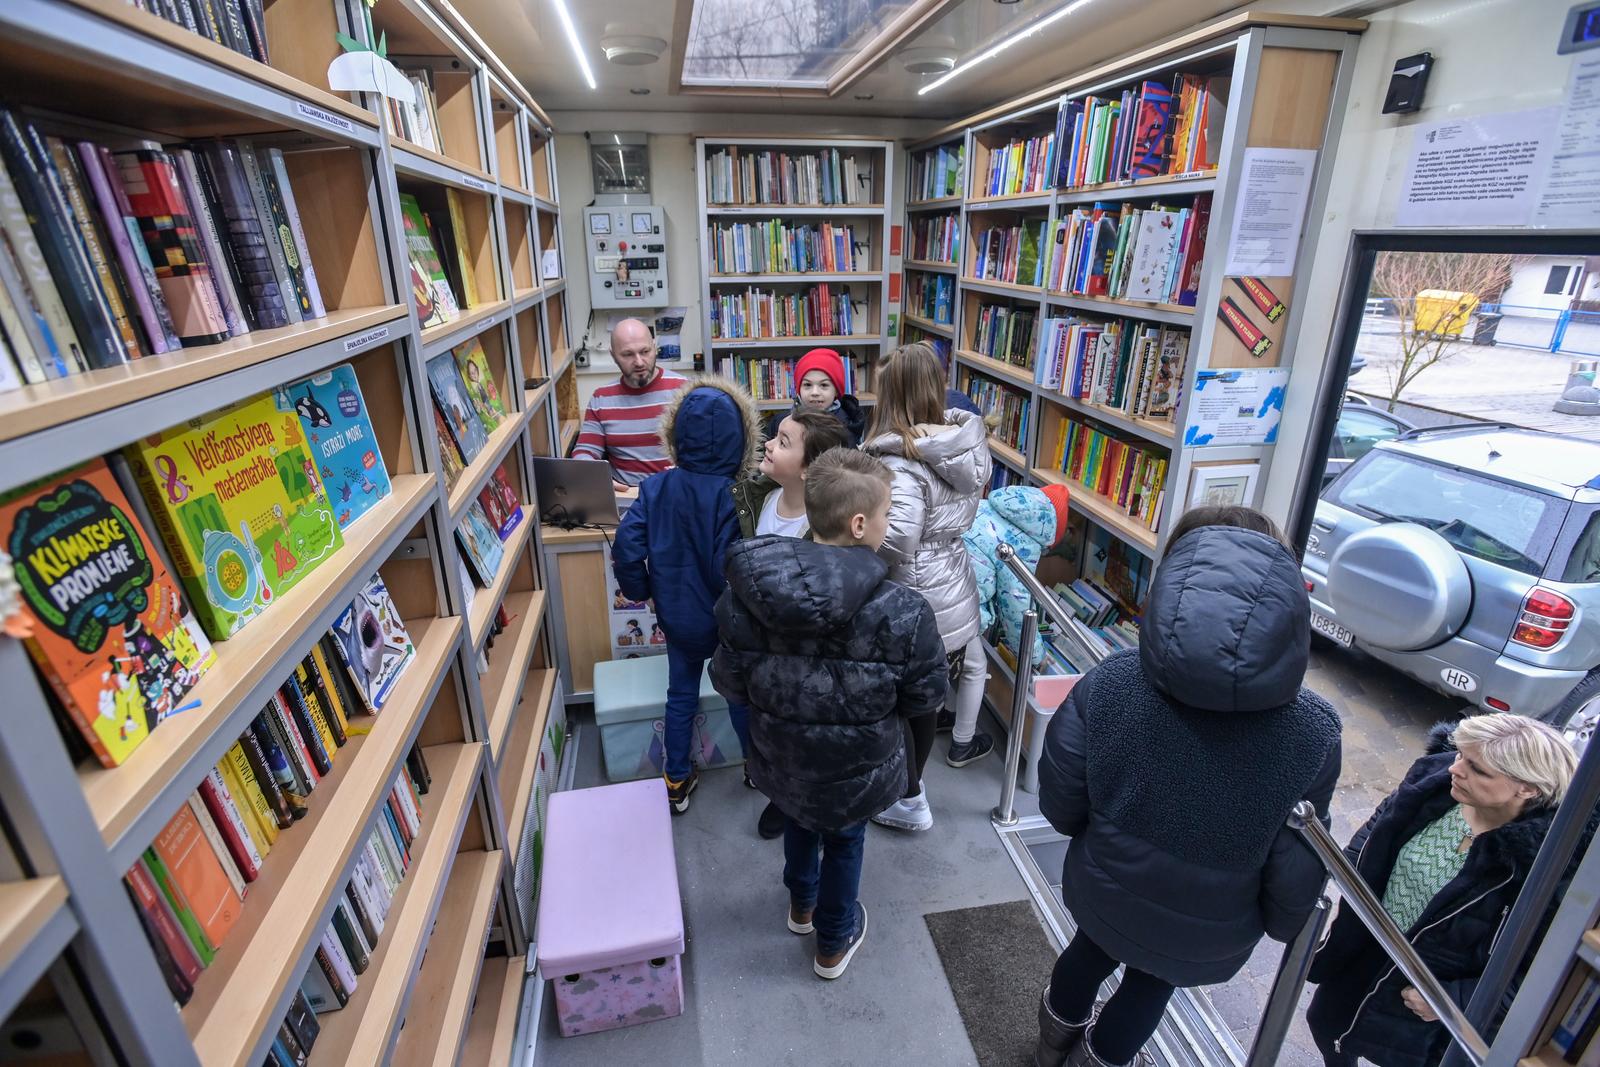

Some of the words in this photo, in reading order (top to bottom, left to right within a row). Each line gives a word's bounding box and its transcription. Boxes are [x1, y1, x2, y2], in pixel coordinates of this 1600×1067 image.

[1082, 337, 1098, 392] ENGLESKI
[184, 422, 275, 478] Veličanstvena
[321, 431, 346, 458] ISTRAŽI
[346, 424, 364, 445] MORE
[214, 454, 277, 504] matematika
[28, 517, 125, 586] KLIMATSKE
[49, 544, 134, 612] PROMJENE
[1446, 668, 1470, 690] HR
[249, 733, 265, 759] Pjevam
